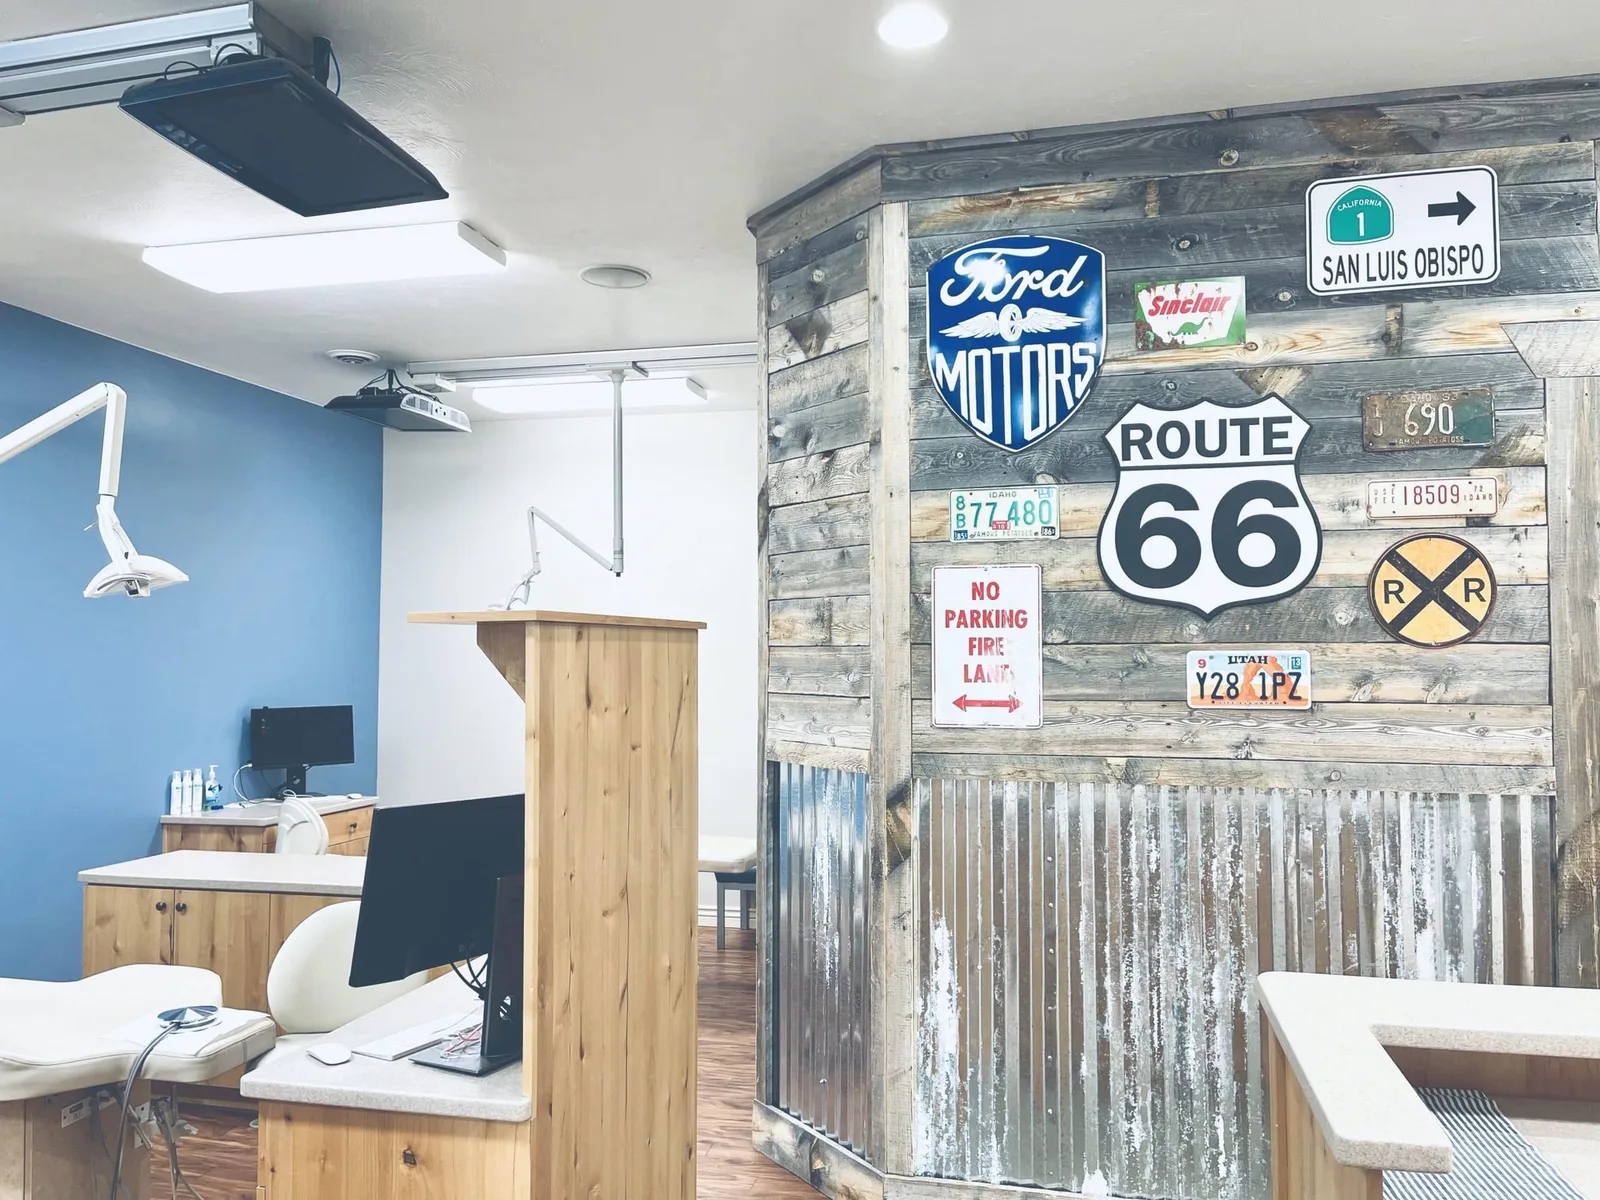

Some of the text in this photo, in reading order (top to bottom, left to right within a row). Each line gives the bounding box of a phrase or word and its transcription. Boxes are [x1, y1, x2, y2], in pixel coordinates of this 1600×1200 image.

[1337, 199, 1382, 211] CALIFORNIA
[1356, 212, 1366, 237] 1
[939, 244, 1088, 307] Ford
[1322, 243, 1484, 286] SAN LUIS OBISPO
[1148, 292, 1231, 316] Sinclair
[935, 341, 1098, 446] MOTORS
[1404, 402, 1454, 437] 690
[1121, 415, 1294, 462] ROUTE
[1403, 484, 1460, 506] 18509
[1463, 493, 1493, 501] IDAHO
[1114, 479, 1302, 589] 66
[971, 581, 1001, 601] NO
[1383, 577, 1486, 604] R R
[945, 609, 1028, 629] PARKING
[968, 637, 1005, 656] FIRE
[1197, 658, 1207, 668] 9
[1227, 655, 1269, 665] UTAH
[1292, 657, 1301, 666] 13
[1196, 671, 1303, 700] Y28 1PZ
